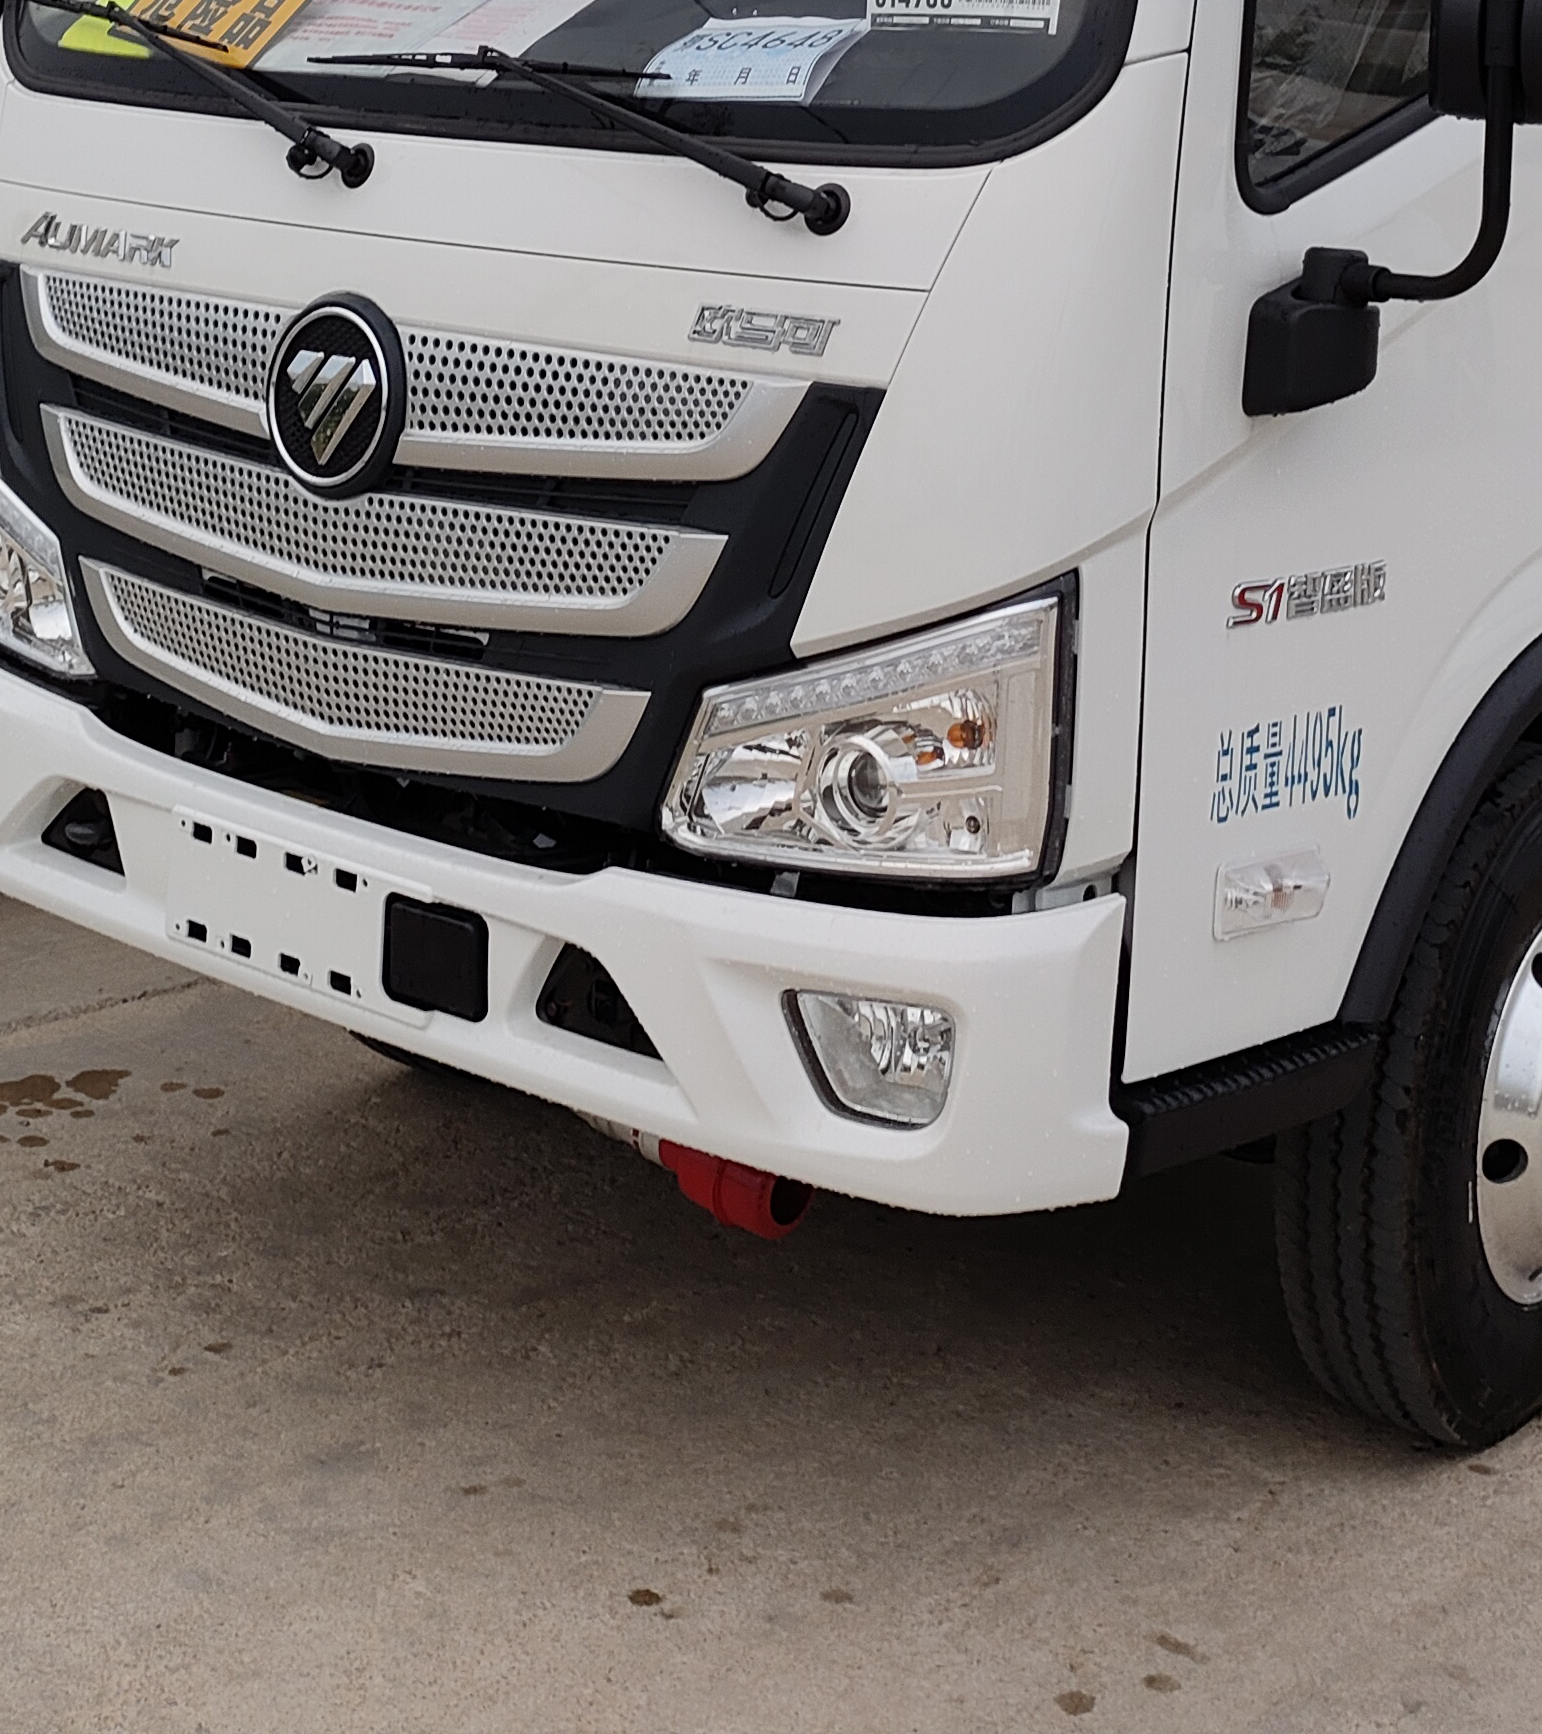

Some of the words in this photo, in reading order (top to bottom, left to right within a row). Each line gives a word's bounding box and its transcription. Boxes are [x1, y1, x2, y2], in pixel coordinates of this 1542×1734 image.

[685, 68, 704, 86] 年
[733, 67, 753, 85] 月
[785, 66, 802, 85] 日
[20, 211, 180, 269] AUMARK
